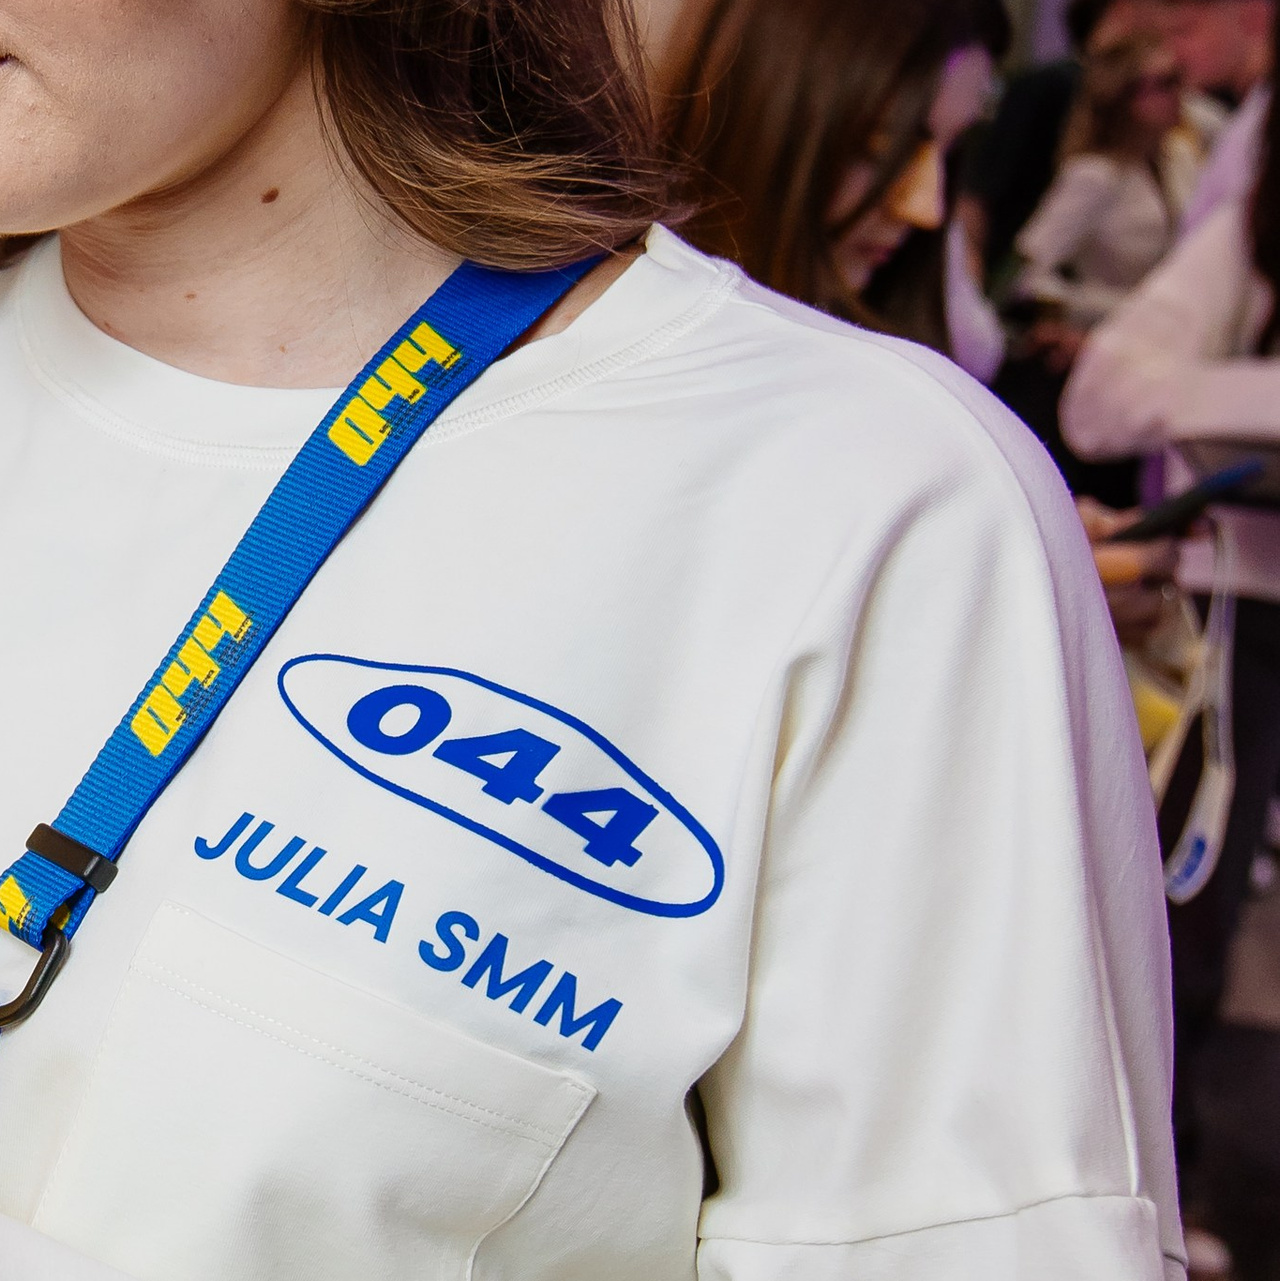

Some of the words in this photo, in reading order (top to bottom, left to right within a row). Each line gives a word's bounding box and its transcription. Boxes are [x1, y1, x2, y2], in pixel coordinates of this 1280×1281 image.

[327, 321, 462, 467] 044
[130, 590, 253, 758] 044
[347, 684, 660, 869] 044
[193, 811, 405, 943] JULIA
[417, 910, 625, 1052] SMM
